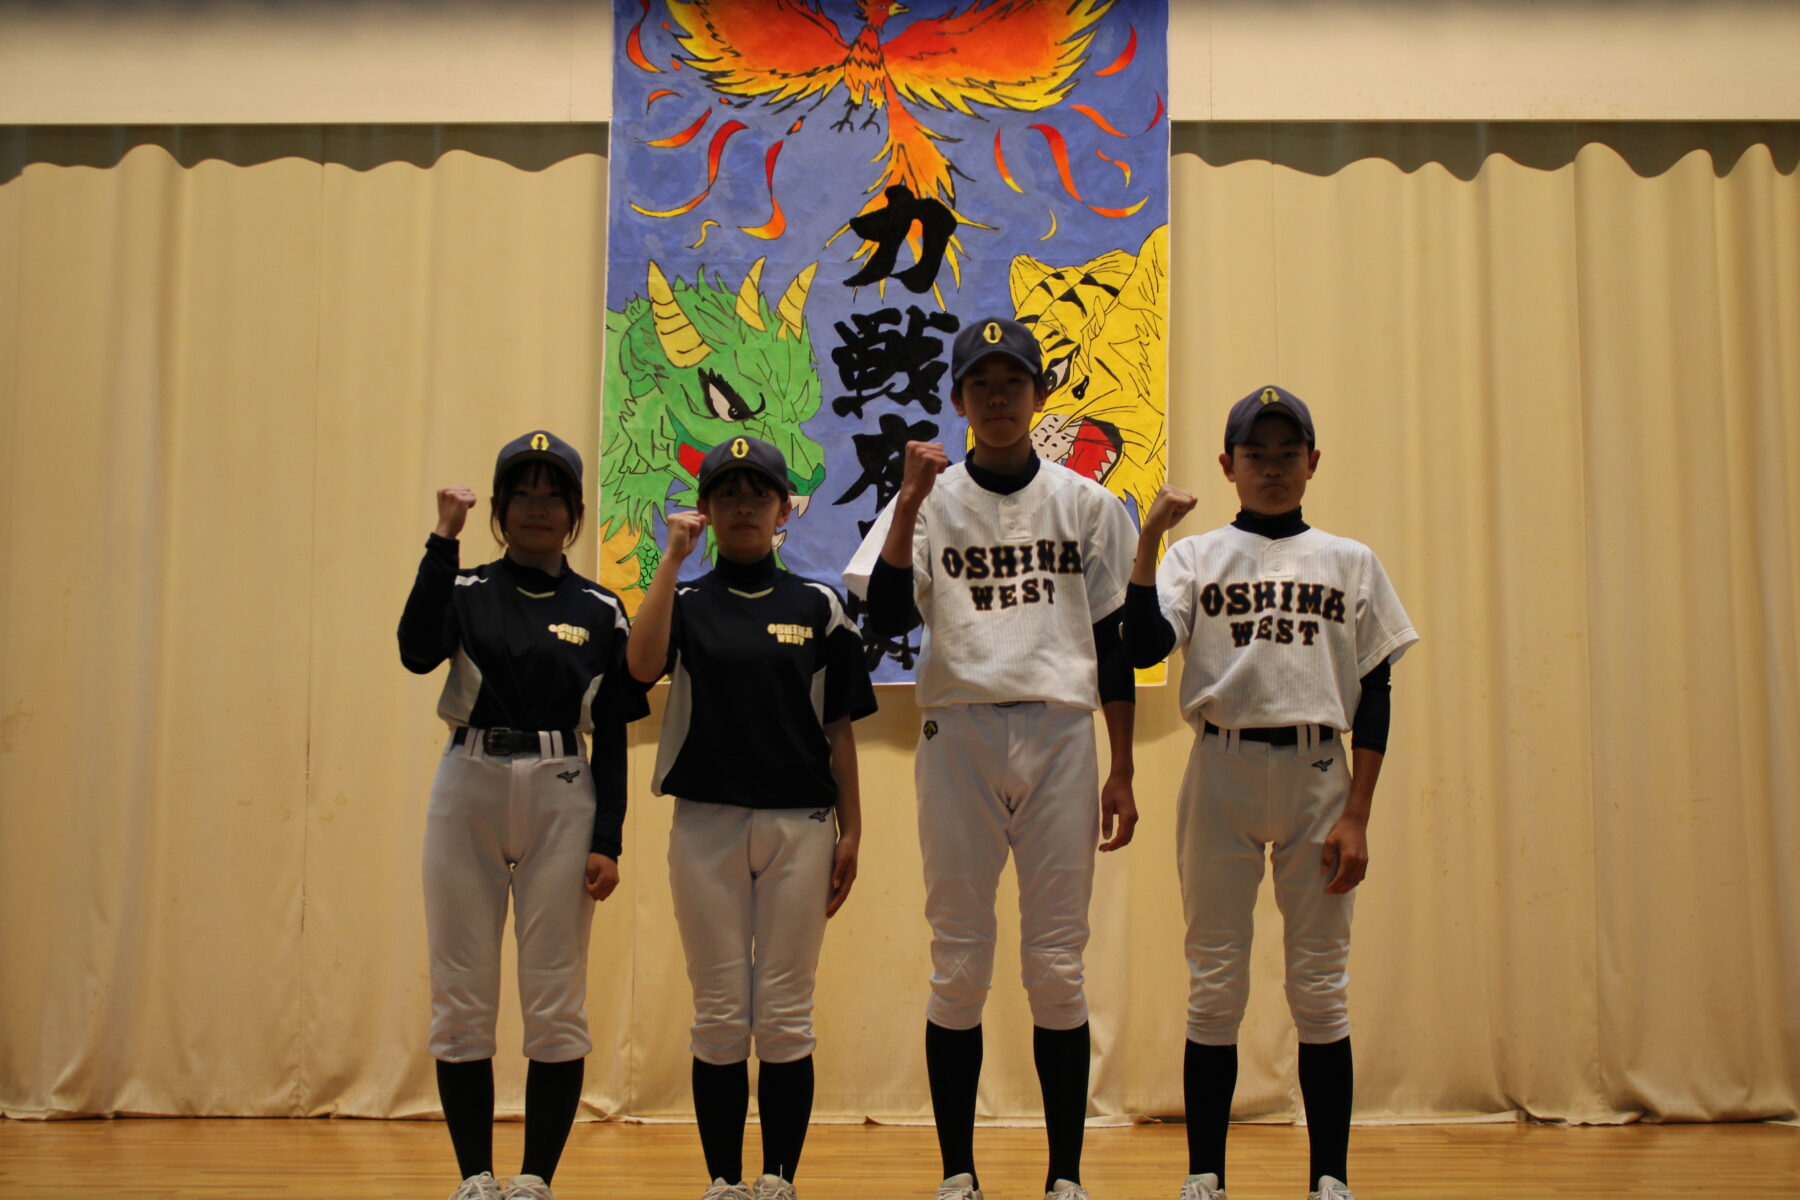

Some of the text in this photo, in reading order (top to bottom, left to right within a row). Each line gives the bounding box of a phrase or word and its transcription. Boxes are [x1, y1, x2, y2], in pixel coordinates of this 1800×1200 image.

[942, 538, 1083, 580] OSHIMA
[970, 577, 1056, 611] WEST
[1200, 580, 1346, 624] OSHIMA
[1230, 615, 1320, 648] WEST
